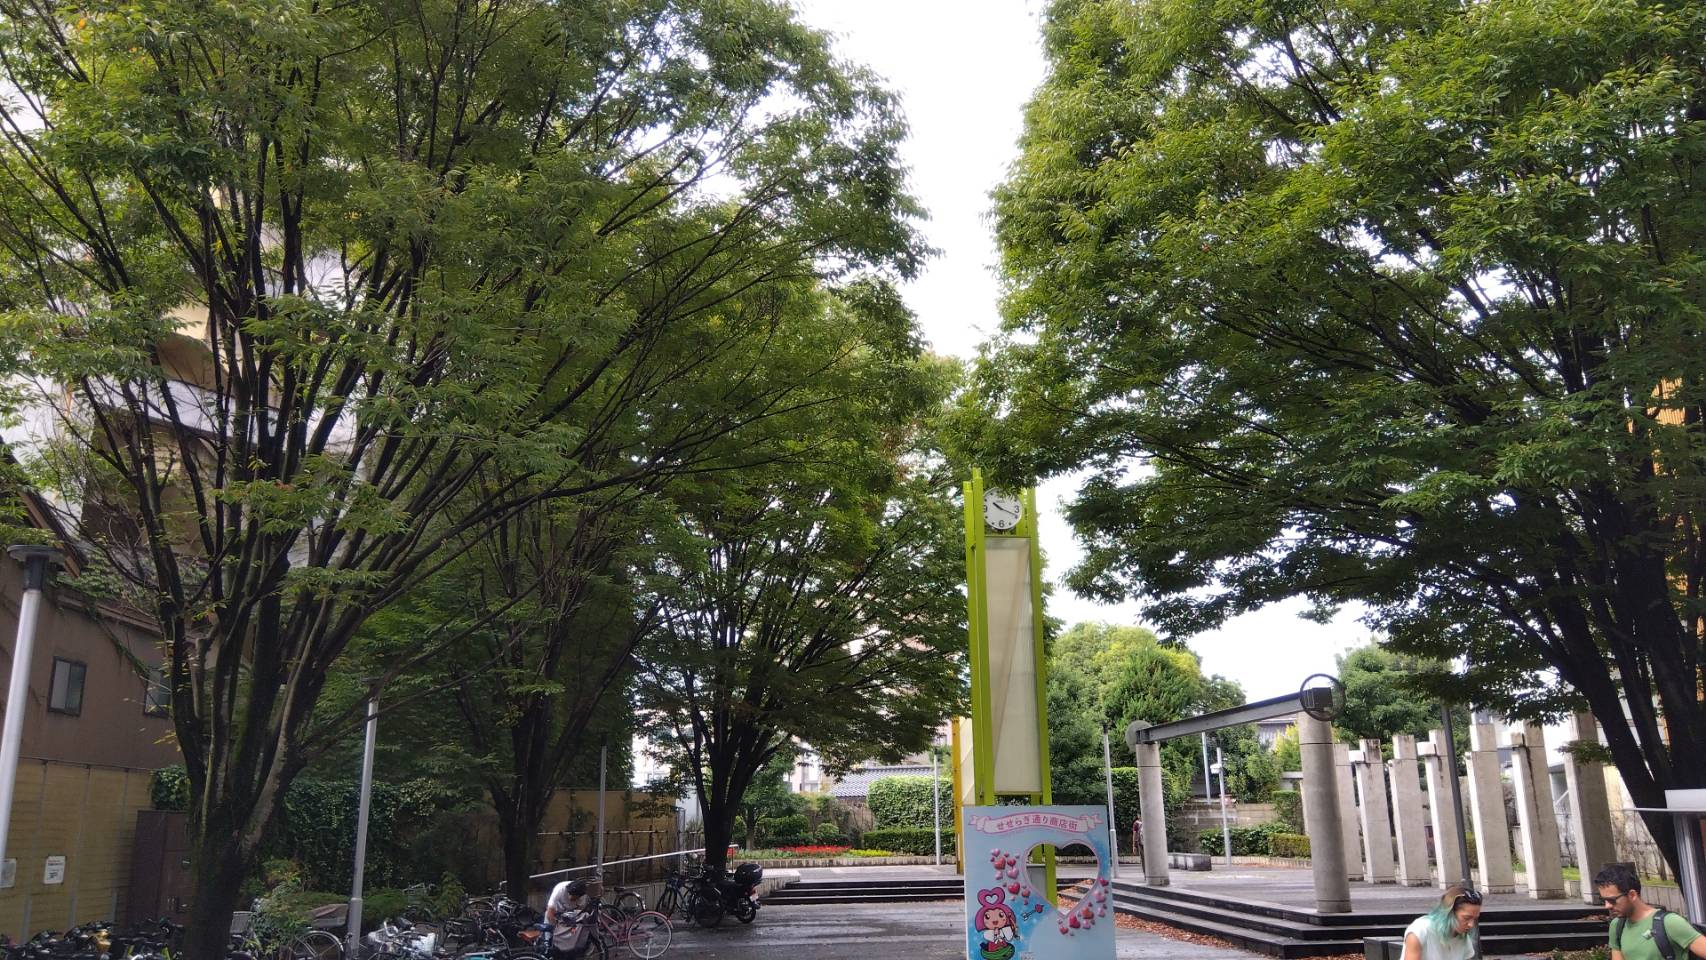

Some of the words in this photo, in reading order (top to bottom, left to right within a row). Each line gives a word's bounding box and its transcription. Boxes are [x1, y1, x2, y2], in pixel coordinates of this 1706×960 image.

[1014, 505, 1020, 513] 3
[997, 815, 1078, 830] せせらぎ通り商店街
